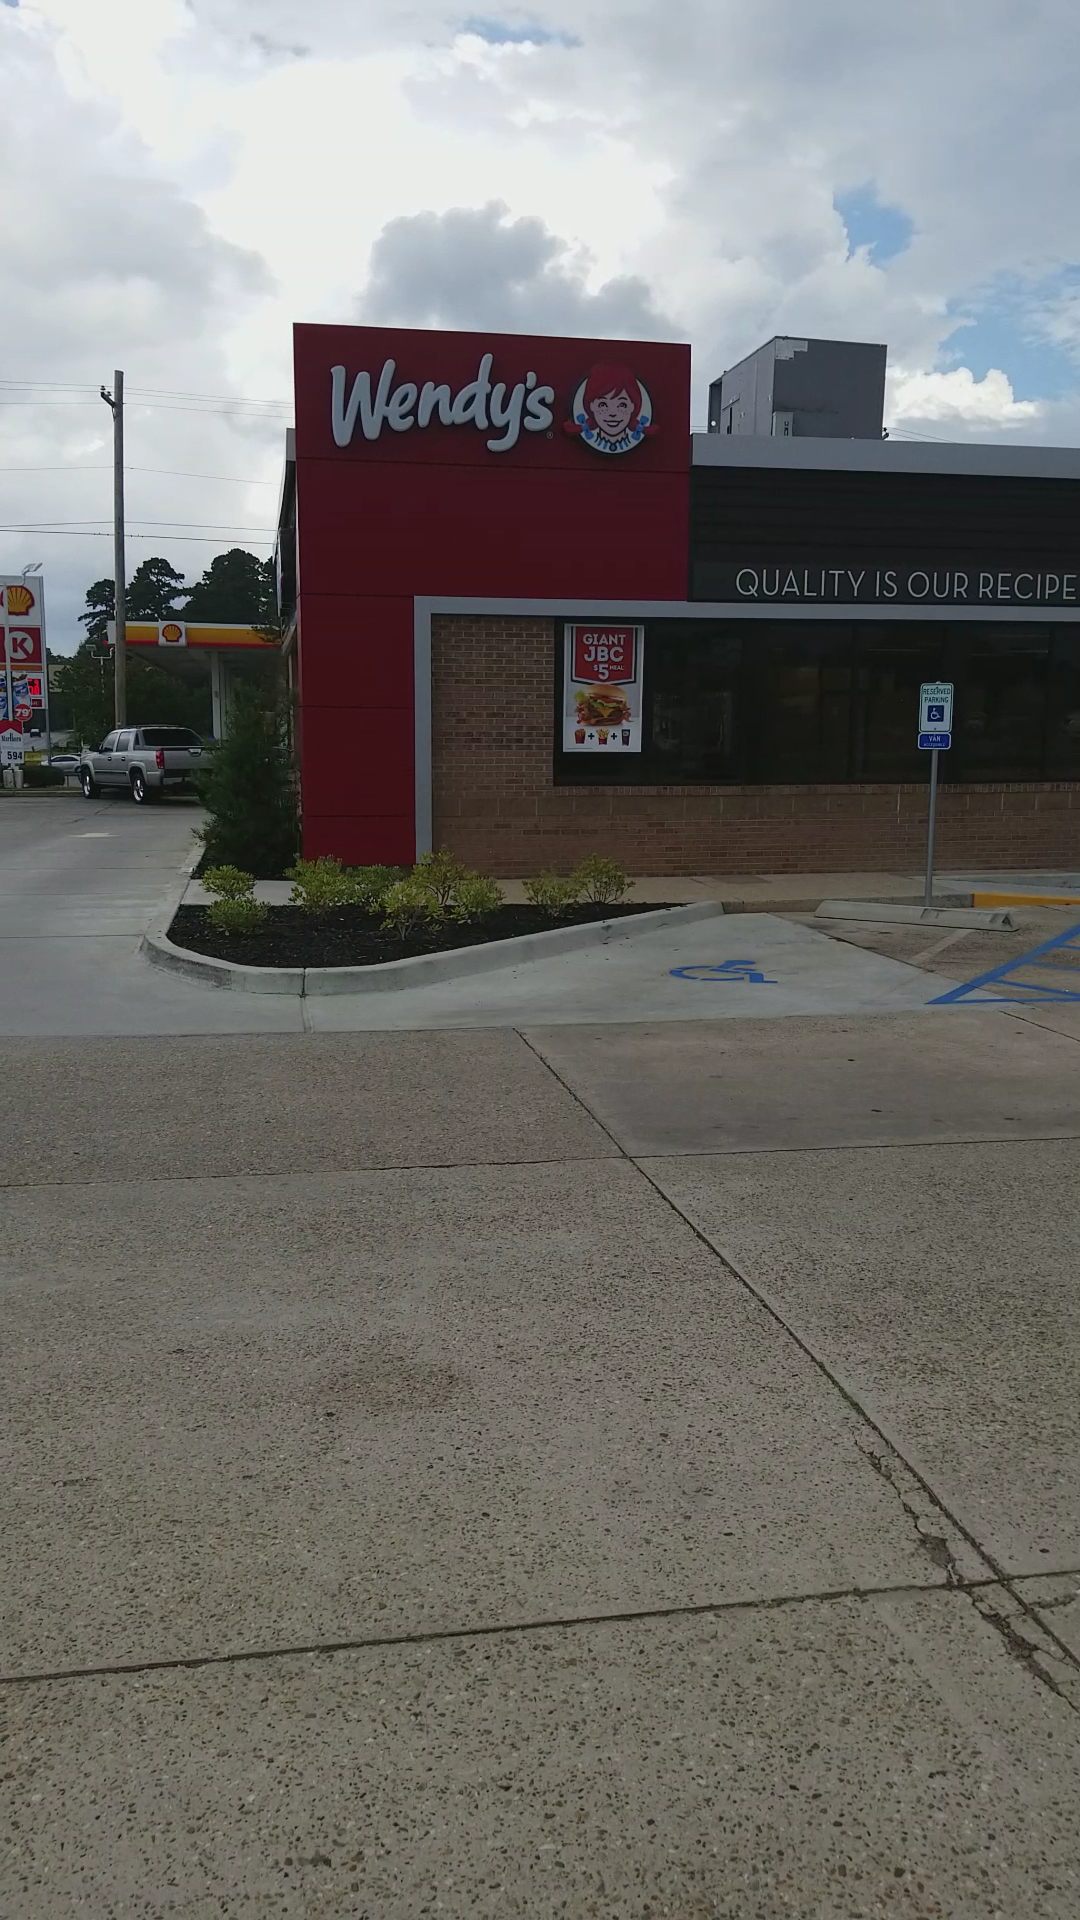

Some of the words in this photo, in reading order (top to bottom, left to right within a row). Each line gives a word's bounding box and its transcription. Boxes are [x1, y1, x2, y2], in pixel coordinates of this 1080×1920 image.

[331, 353, 555, 452] Wendy's
[735, 568, 865, 597] QUALITY
[875, 571, 898, 597] IS
[907, 571, 969, 598] OUR
[978, 572, 1078, 600] RECIPE
[12, 637, 31, 657] K
[583, 633, 627, 645] GIANT
[583, 646, 624, 662] JBC
[7, 751, 23, 760] 594
